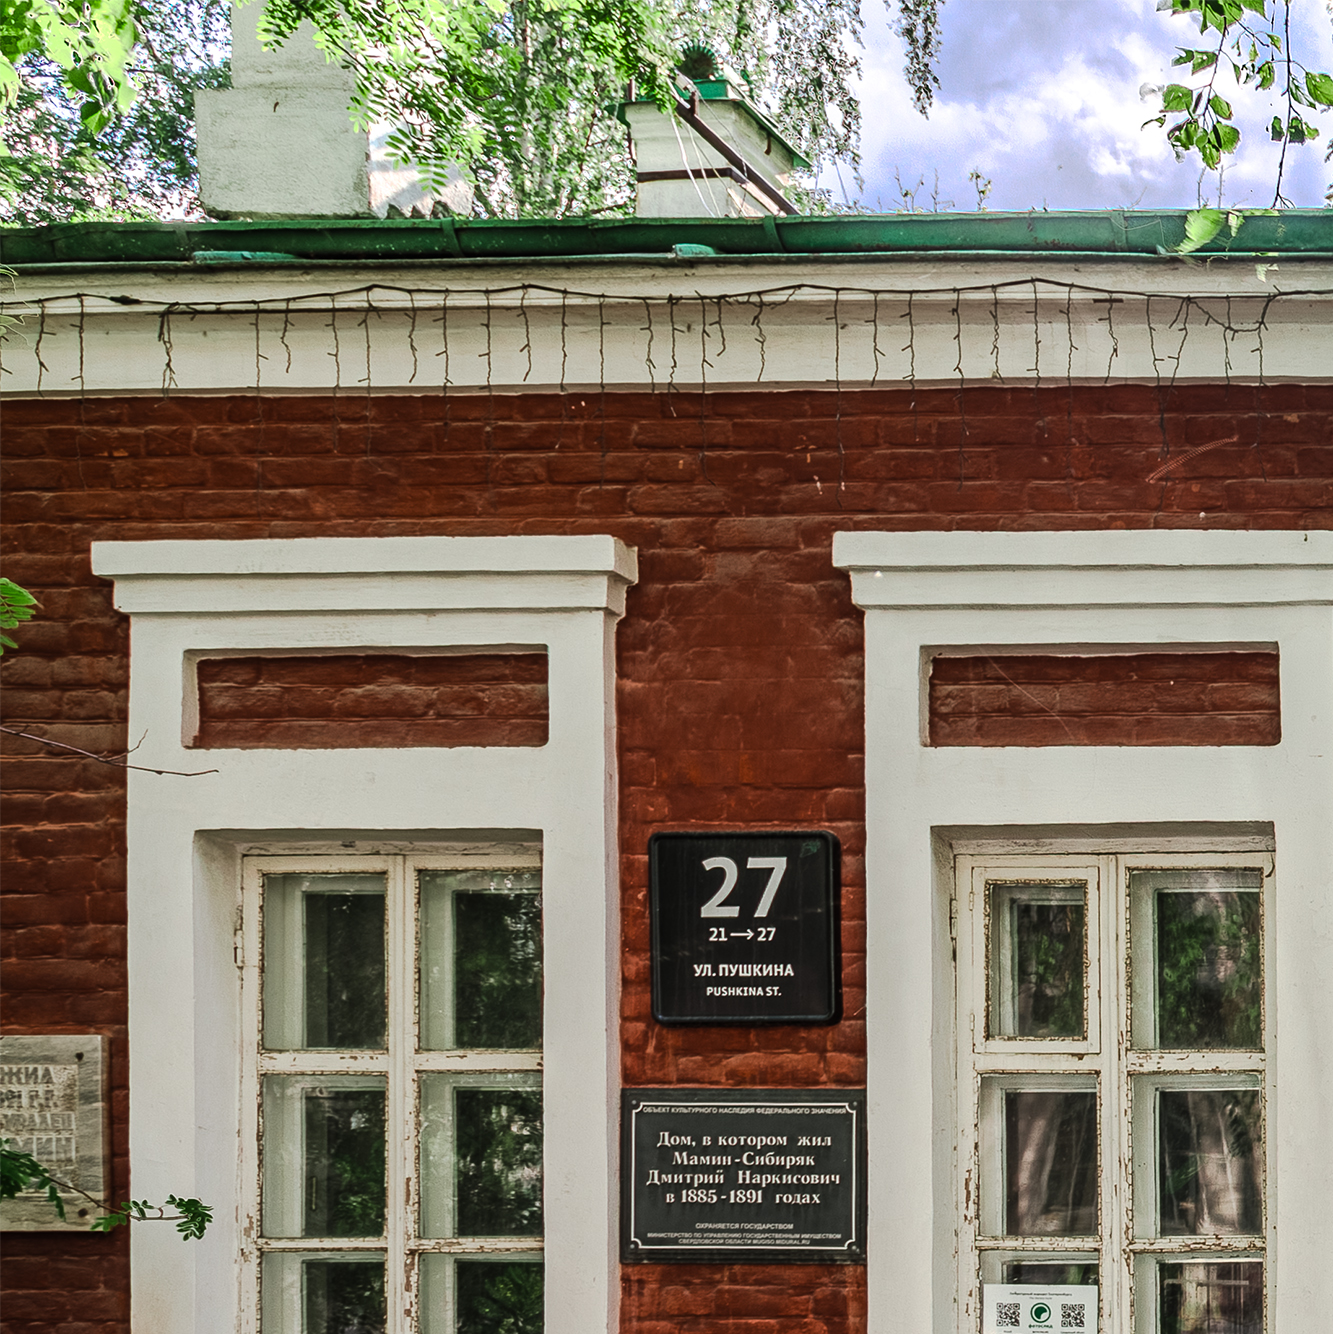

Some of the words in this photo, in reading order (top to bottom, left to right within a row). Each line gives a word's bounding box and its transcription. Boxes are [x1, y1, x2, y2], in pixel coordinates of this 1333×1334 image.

[700, 856, 788, 918] 27
[708, 927, 728, 942] 21
[757, 927, 777, 942] 27
[693, 963, 717, 977] УЛ.
[718, 963, 795, 977] ПУШКИНА
[706, 986, 764, 997] PUSHKINA
[765, 986, 782, 997] ST.
[656, 1131, 696, 1147] Дом,
[702, 1135, 712, 1146] в
[718, 1135, 788, 1150] котором
[797, 1135, 832, 1147] жил
[646, 1169, 725, 1188] Дмитрий
[737, 1169, 841, 1188] Наркисович
[665, 1192, 676, 1204] в
[775, 1193, 821, 1205] годах
